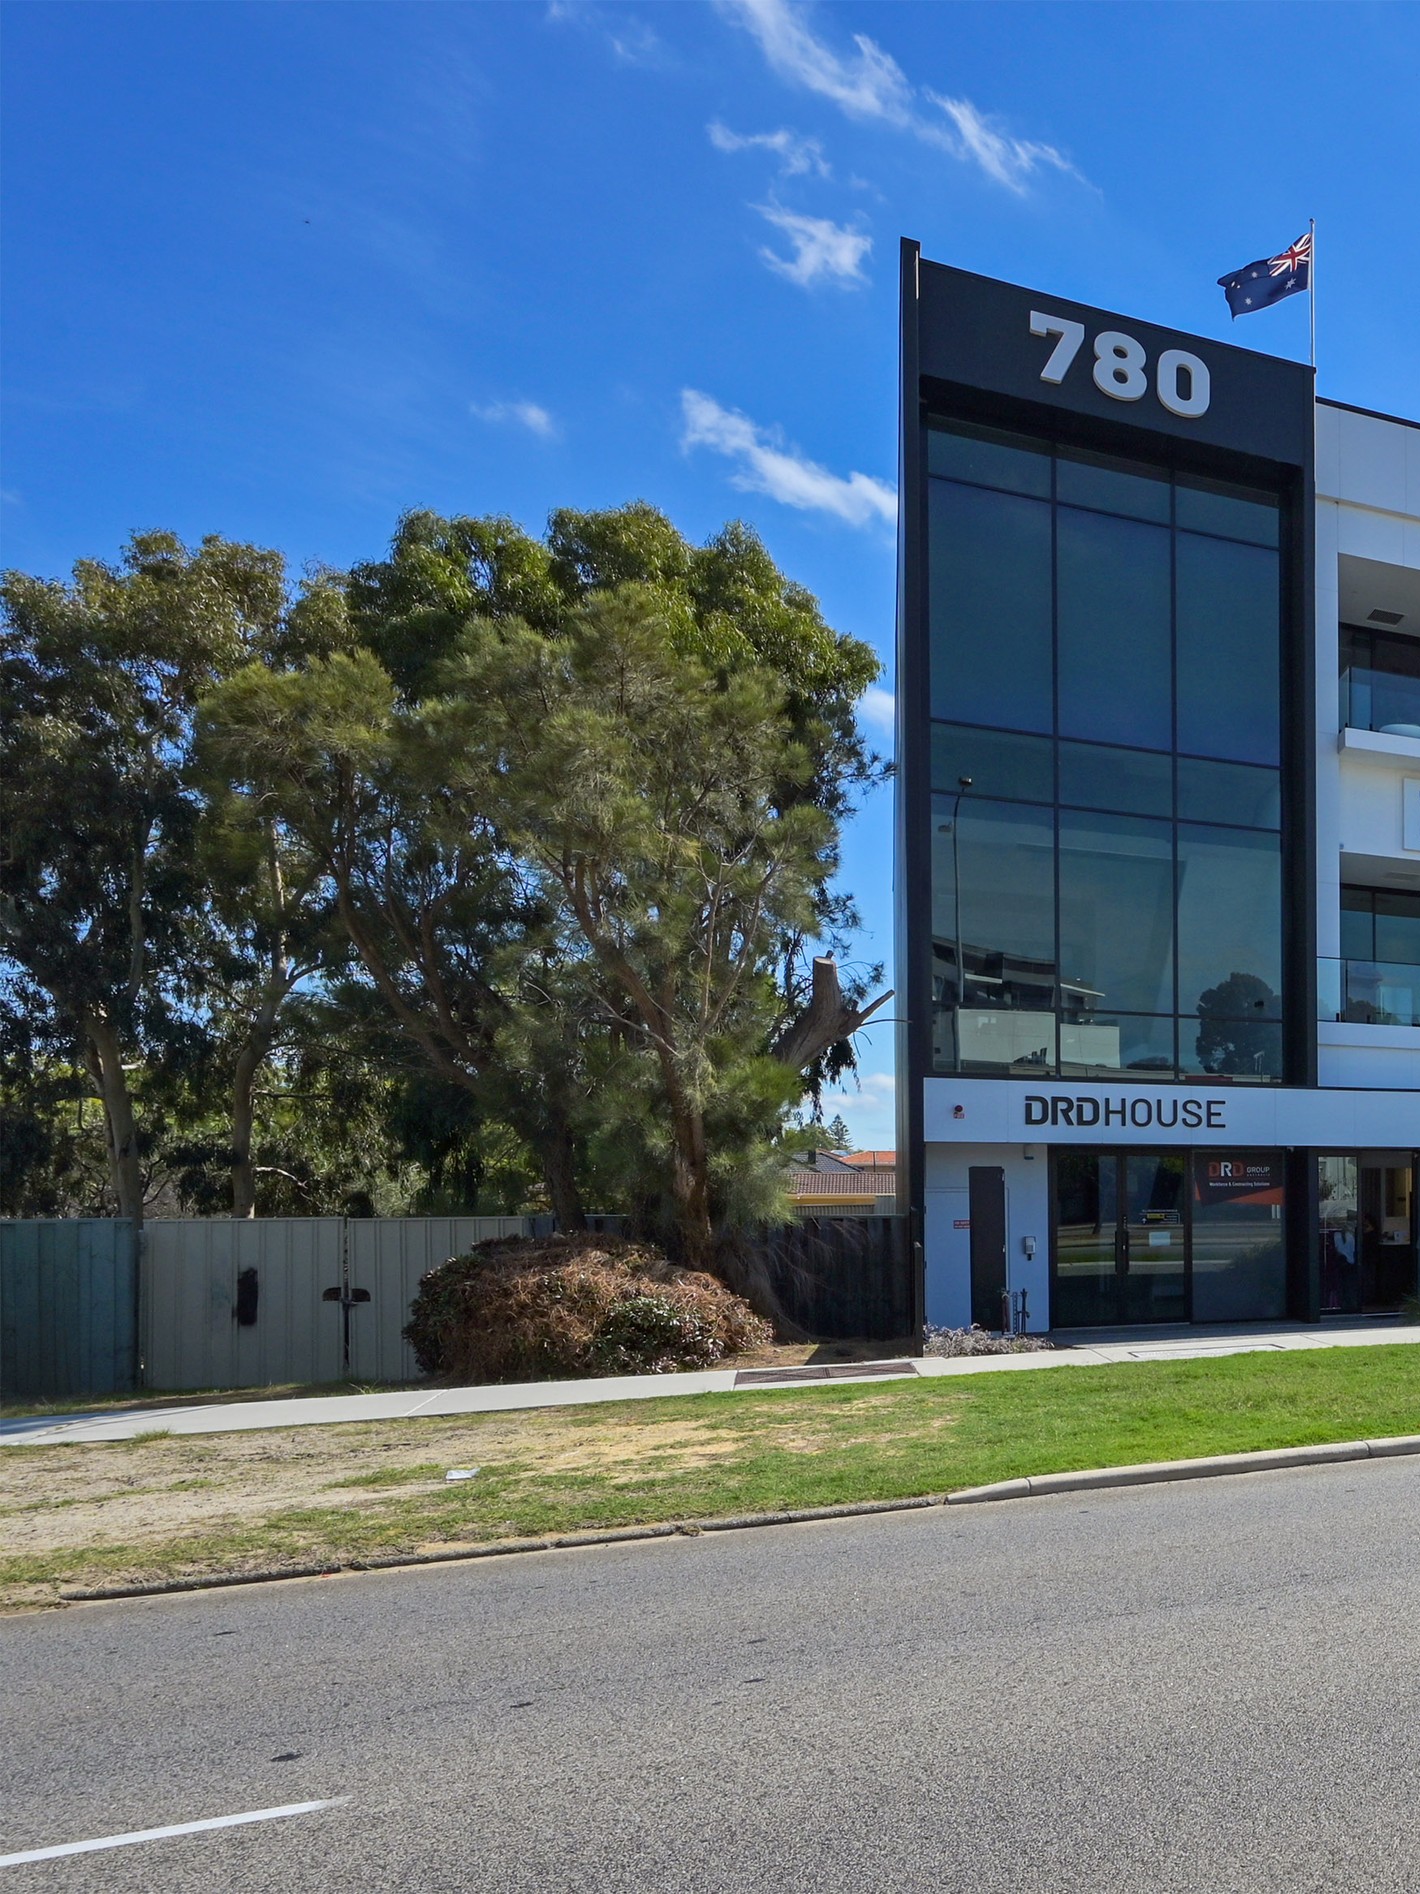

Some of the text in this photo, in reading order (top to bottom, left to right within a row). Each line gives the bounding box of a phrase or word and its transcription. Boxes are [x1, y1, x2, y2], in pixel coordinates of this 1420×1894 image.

[1030, 310, 1210, 418] 780
[1208, 1162, 1271, 1177] DRD GROUP
